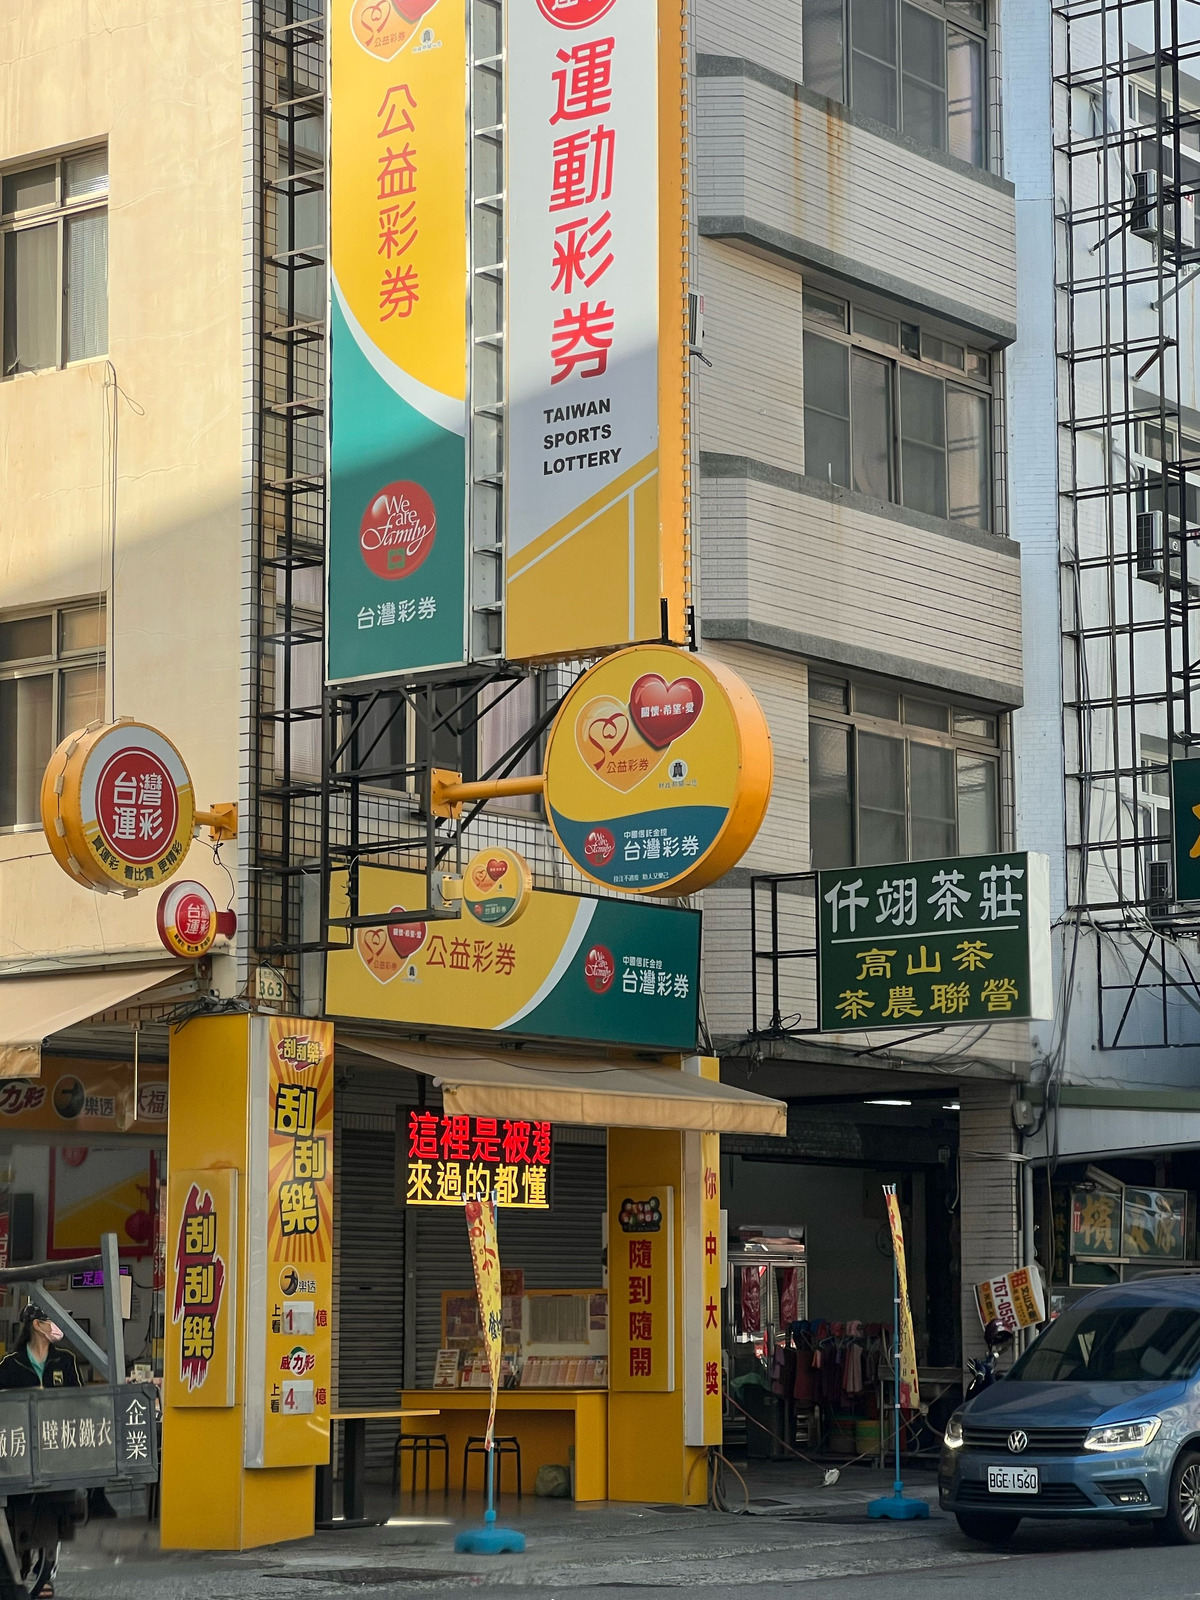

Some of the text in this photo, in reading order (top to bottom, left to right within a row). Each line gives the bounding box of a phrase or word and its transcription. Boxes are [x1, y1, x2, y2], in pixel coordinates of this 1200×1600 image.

[377, 83, 420, 322] 公益彩券
[549, 36, 616, 386] 運動彩券
[543, 398, 611, 424] TAIWAN
[543, 424, 612, 450] SPORTS
[543, 448, 622, 476] LOTTERY
[357, 596, 437, 630] 台灣彩券
[606, 758, 649, 774] 公益彩券
[113, 772, 162, 806] 台灣
[112, 806, 163, 841] 運彩
[623, 828, 668, 839] 中國信託金控
[624, 835, 700, 861] 台灣彩券
[824, 863, 1025, 934] 仟翊茶莊
[426, 935, 516, 976] 公益彩券
[622, 956, 663, 970] 中國信託金控
[855, 940, 994, 981] 高山茶
[622, 967, 689, 999] 台灣彩券
[835, 978, 1019, 1020] 茶農聯營
[283, 1037, 322, 1064] 刮刮樂
[275, 1083, 327, 1237] 刮刮樂
[406, 1160, 547, 1204] 來過的都懂
[182, 1212, 217, 1361] 刮刮樂
[271, 1303, 281, 1334] 上看
[316, 1309, 328, 1327] 億
[628, 1239, 653, 1377] 隨到隨開
[280, 1354, 315, 1372] 威力彩
[270, 1383, 281, 1414] 上看
[315, 1387, 328, 1406] 億
[41, 1417, 113, 1451] 壁板鐵衣
[125, 1398, 148, 1460] 企業
